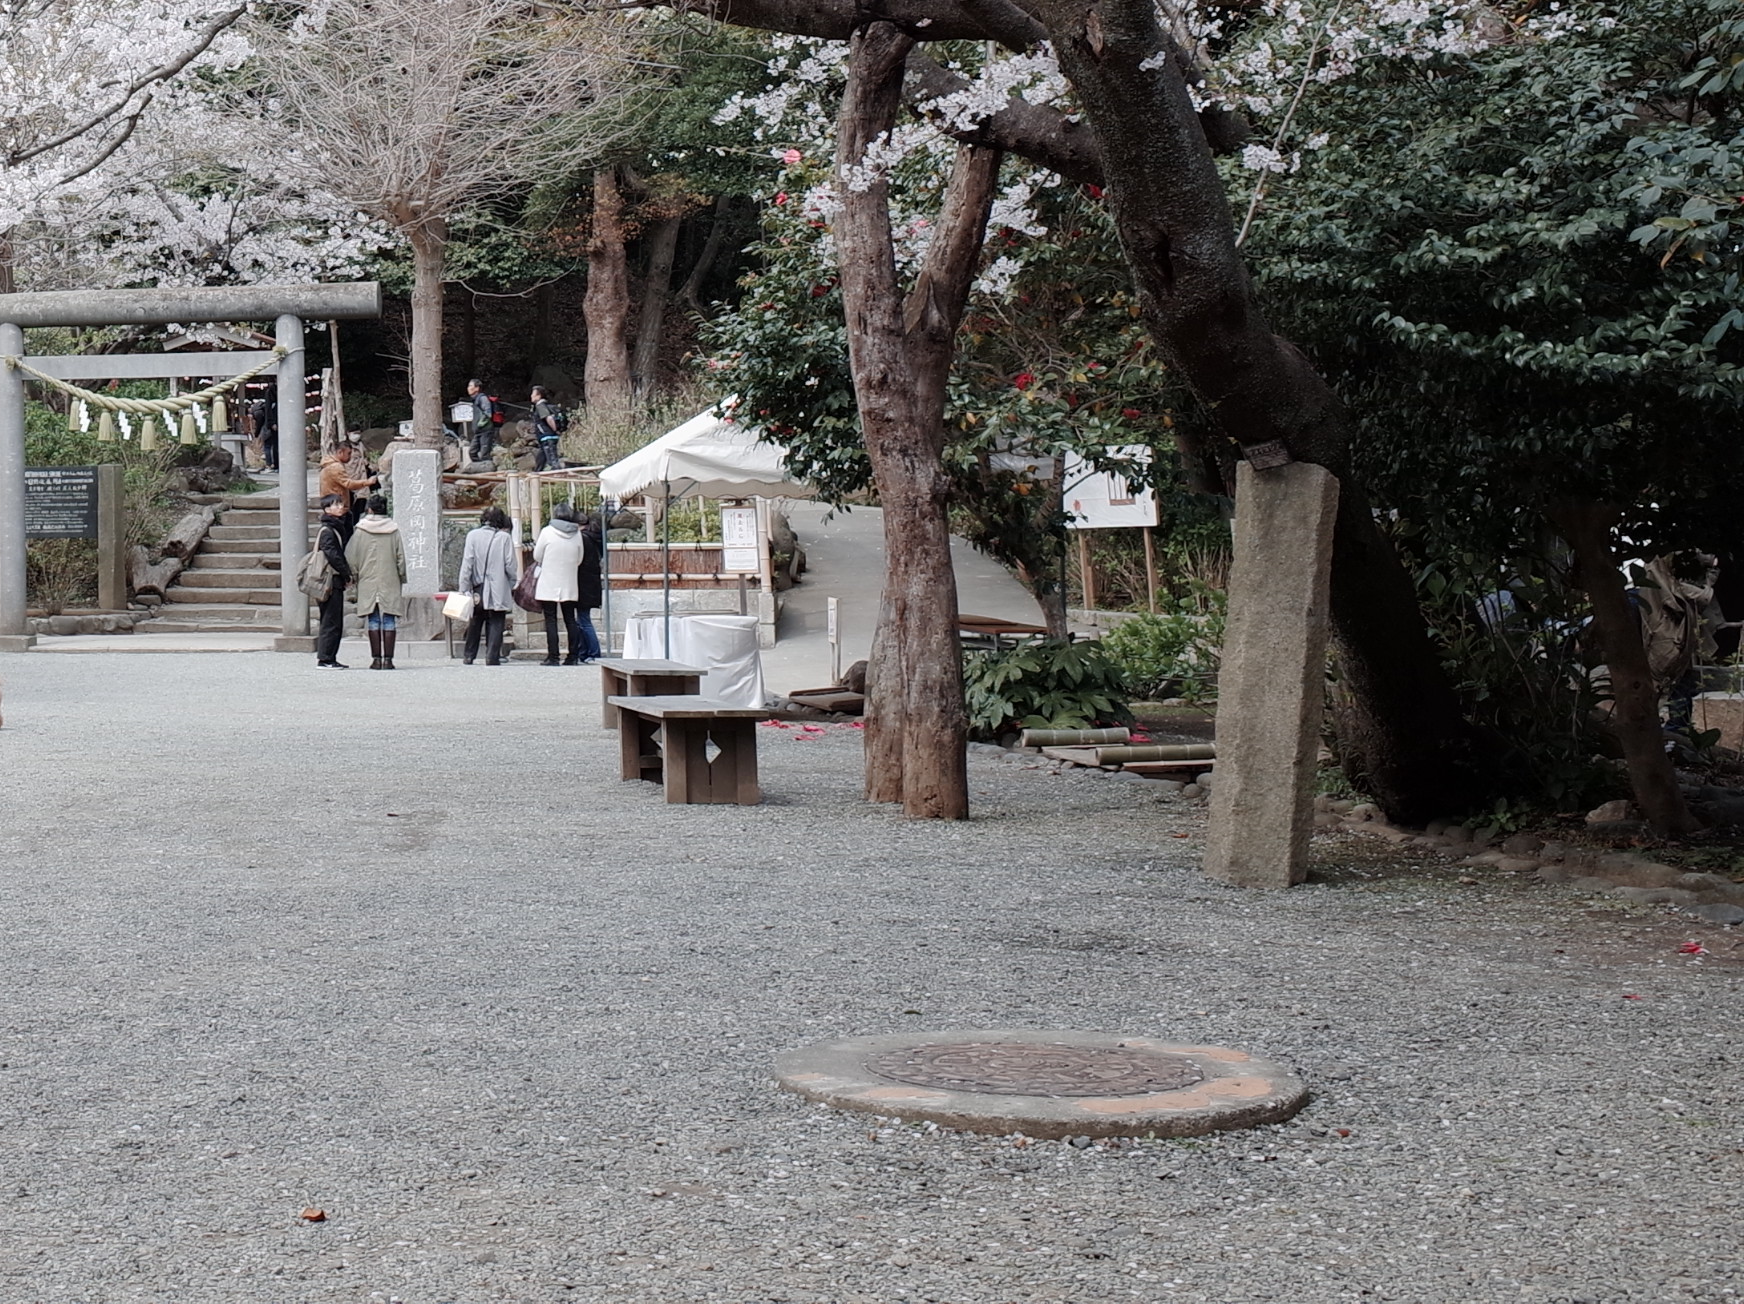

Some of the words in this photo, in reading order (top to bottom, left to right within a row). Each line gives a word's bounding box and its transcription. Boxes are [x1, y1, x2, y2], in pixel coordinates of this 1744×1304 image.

[406, 468, 428, 570] 葛原岡神社
